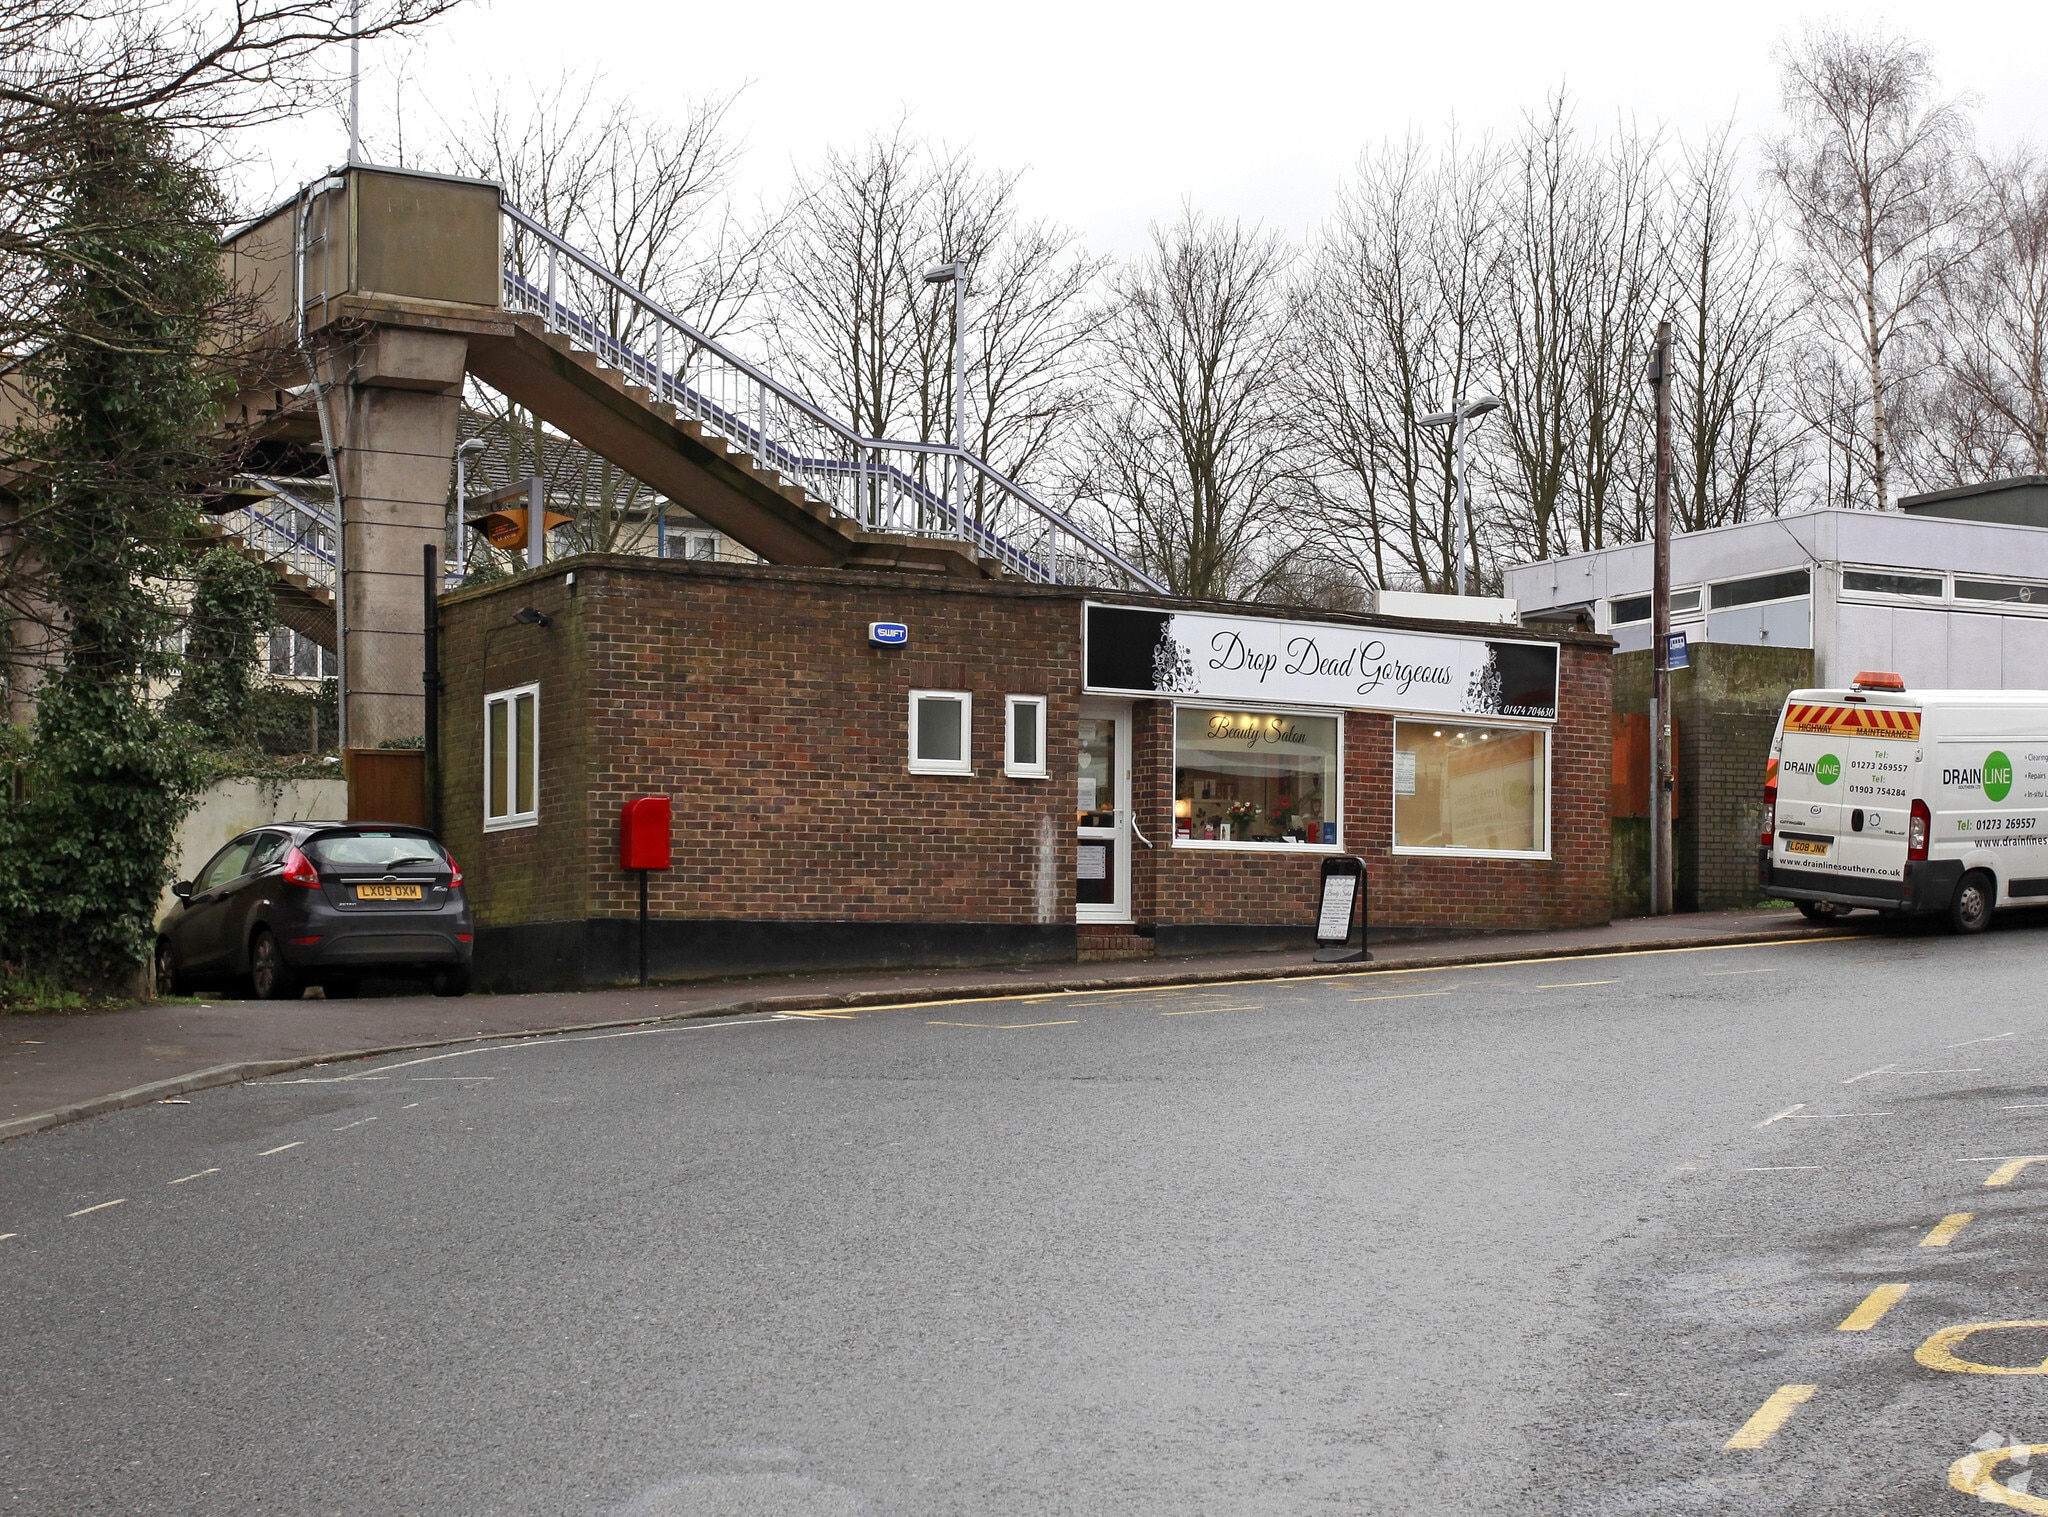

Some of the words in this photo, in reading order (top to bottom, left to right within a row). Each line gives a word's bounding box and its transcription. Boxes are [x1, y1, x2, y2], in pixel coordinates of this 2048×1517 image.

[1208, 630, 1278, 683] Drop
[1284, 636, 1357, 676] Dead
[1356, 640, 1453, 695] Gorgeous
[1503, 704, 1526, 715] 01474
[1526, 706, 1555, 717] 704630
[1207, 715, 1260, 748] Beauty
[1263, 718, 1307, 744] Salon
[1798, 723, 1832, 734] HIGHWAY
[1856, 727, 1912, 739] MAINTENANCE
[1874, 750, 1889, 759] Tel:
[1851, 761, 1876, 770] 01273
[1878, 763, 1908, 773] 269557
[1871, 774, 1886, 783] Tel:
[2027, 772, 2046, 780] Repairs
[1849, 785, 1874, 794] 01903
[1876, 787, 1906, 797] 754284
[1957, 819, 1973, 831] Tel:
[1976, 819, 2002, 831] 01273
[2005, 818, 2036, 830] 269557
[1790, 841, 1810, 852] LG08
[1810, 844, 1827, 854] JNX
[1779, 858, 1901, 876] www.drainlinesouthern.co.uk
[362, 886, 392, 897] LX09
[394, 886, 418, 897] OXM
